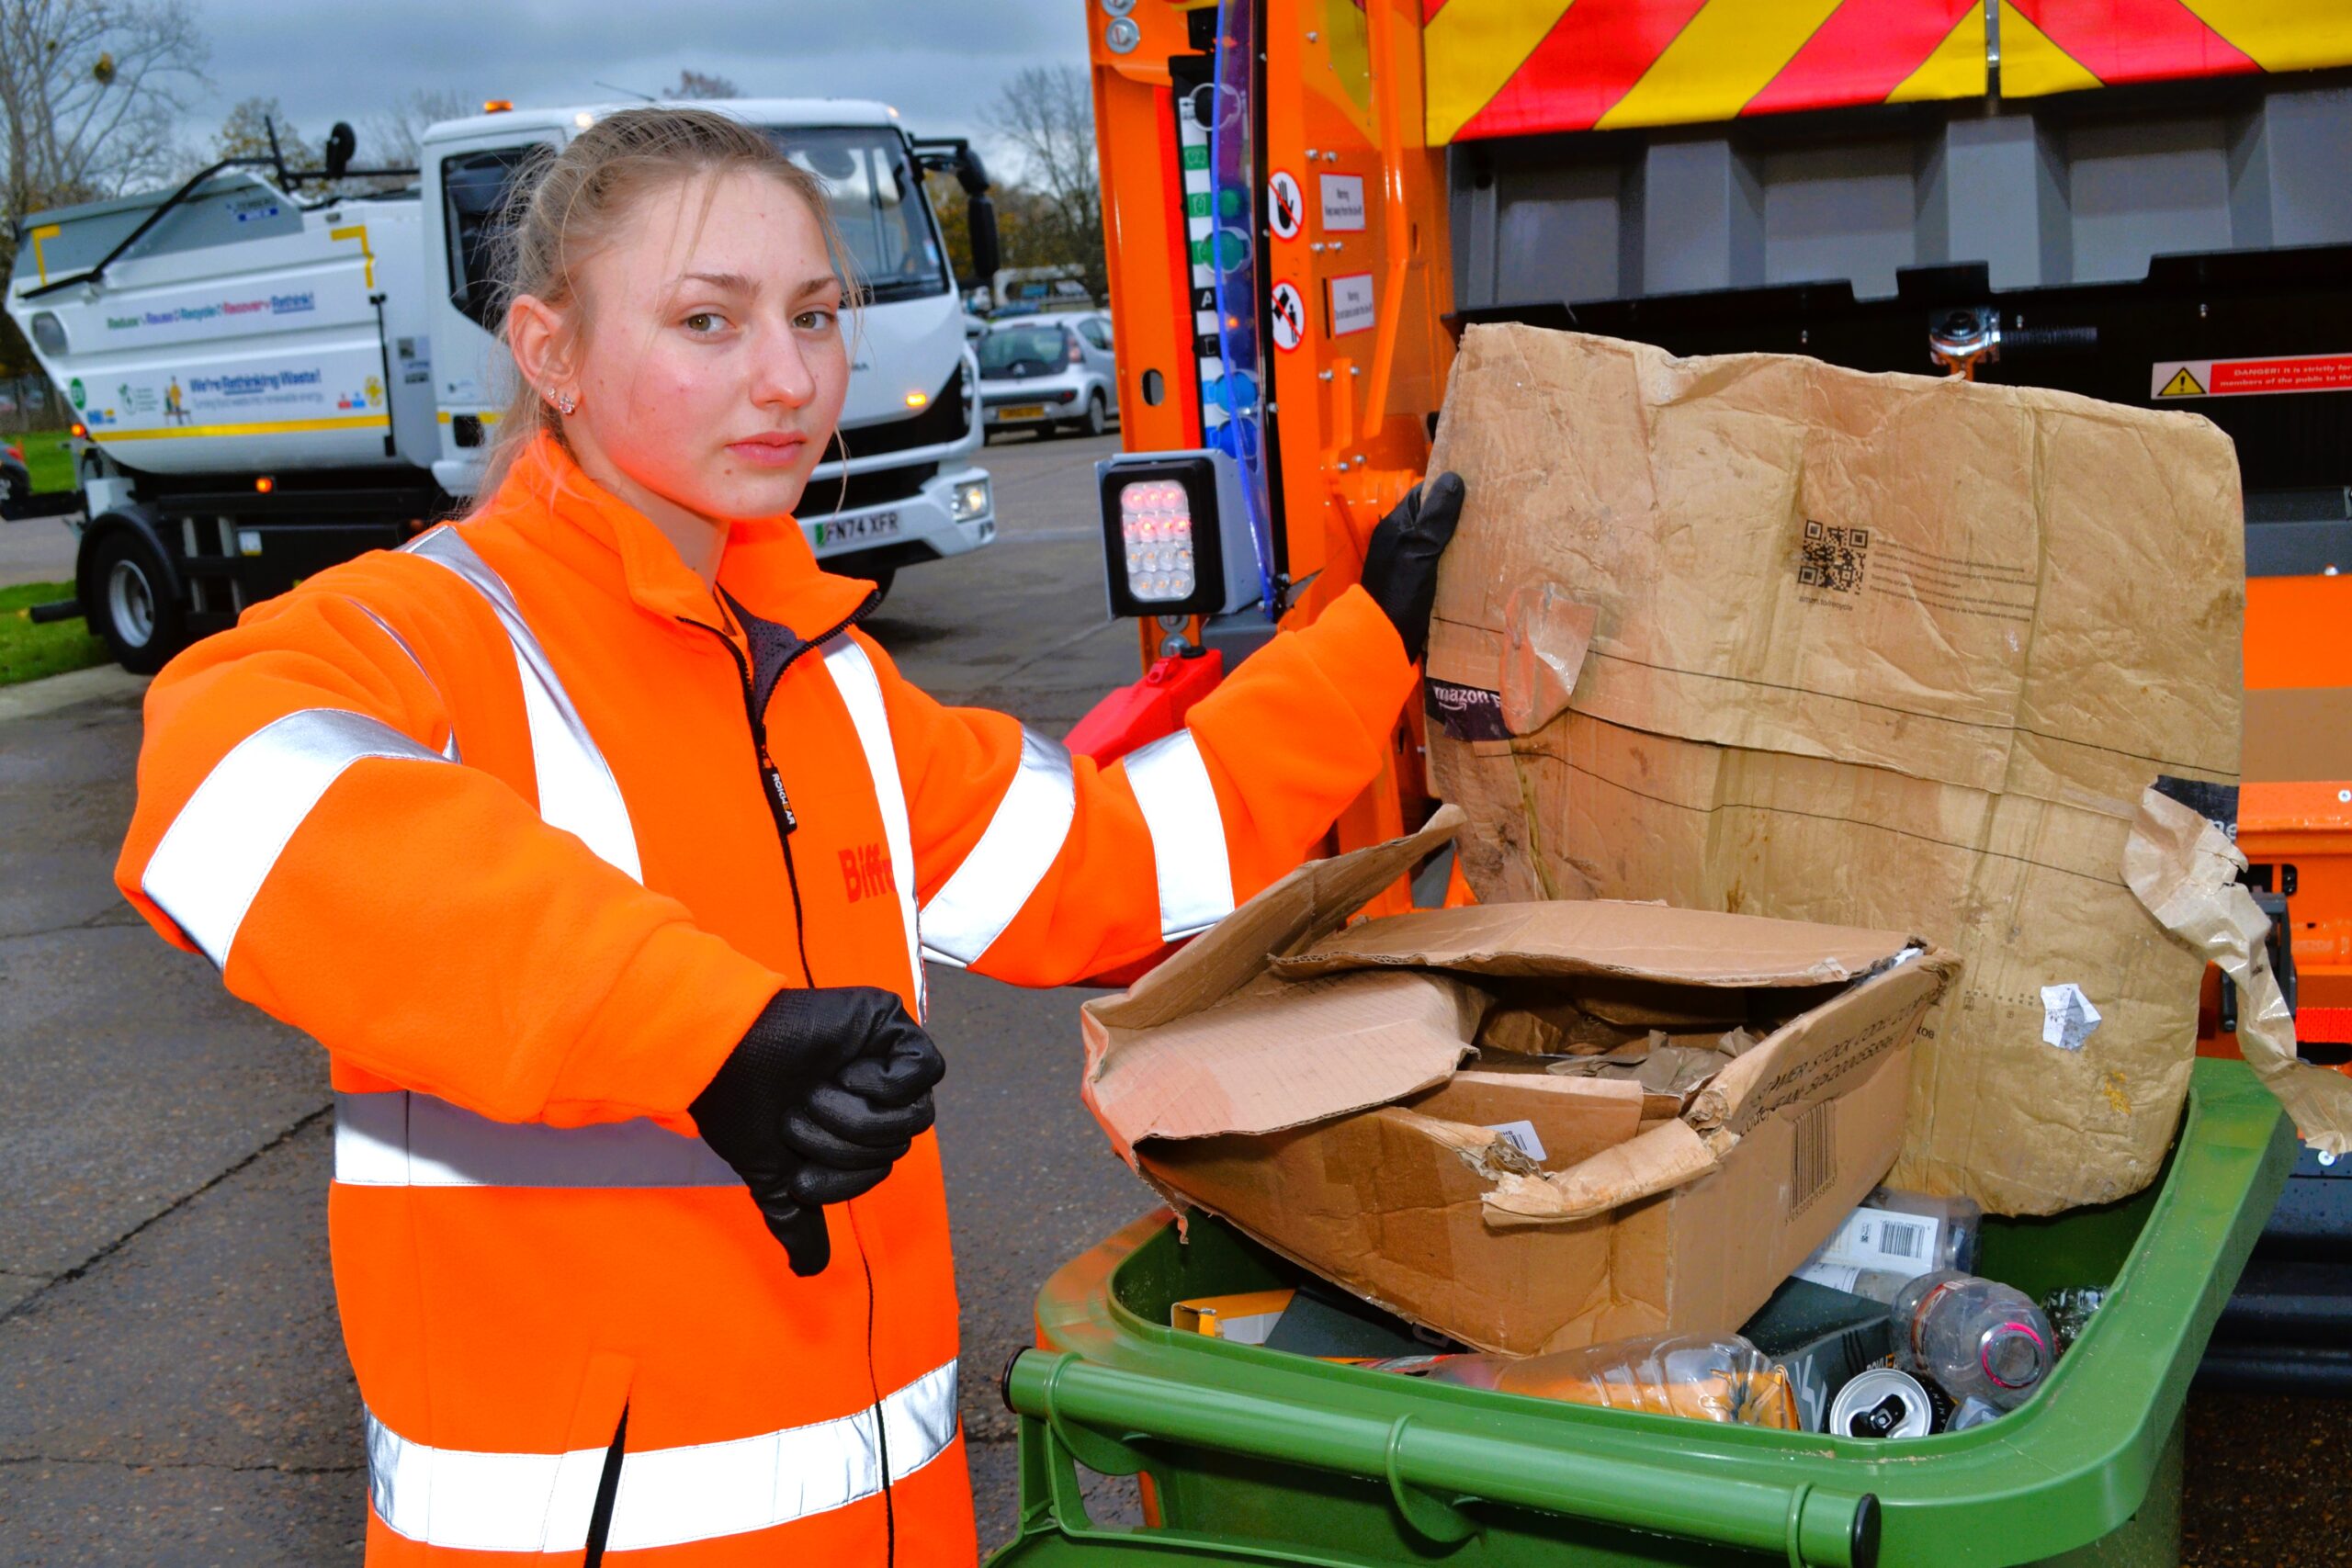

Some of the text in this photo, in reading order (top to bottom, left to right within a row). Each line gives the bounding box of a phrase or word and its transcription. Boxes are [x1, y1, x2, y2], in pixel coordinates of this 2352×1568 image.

[2303, 365, 2335, 373] strictly
[221, 373, 278, 390] Rethinking
[2295, 375, 2323, 384] public
[827, 512, 898, 541] FN74 XFR
[1433, 686, 1490, 705] mazon
